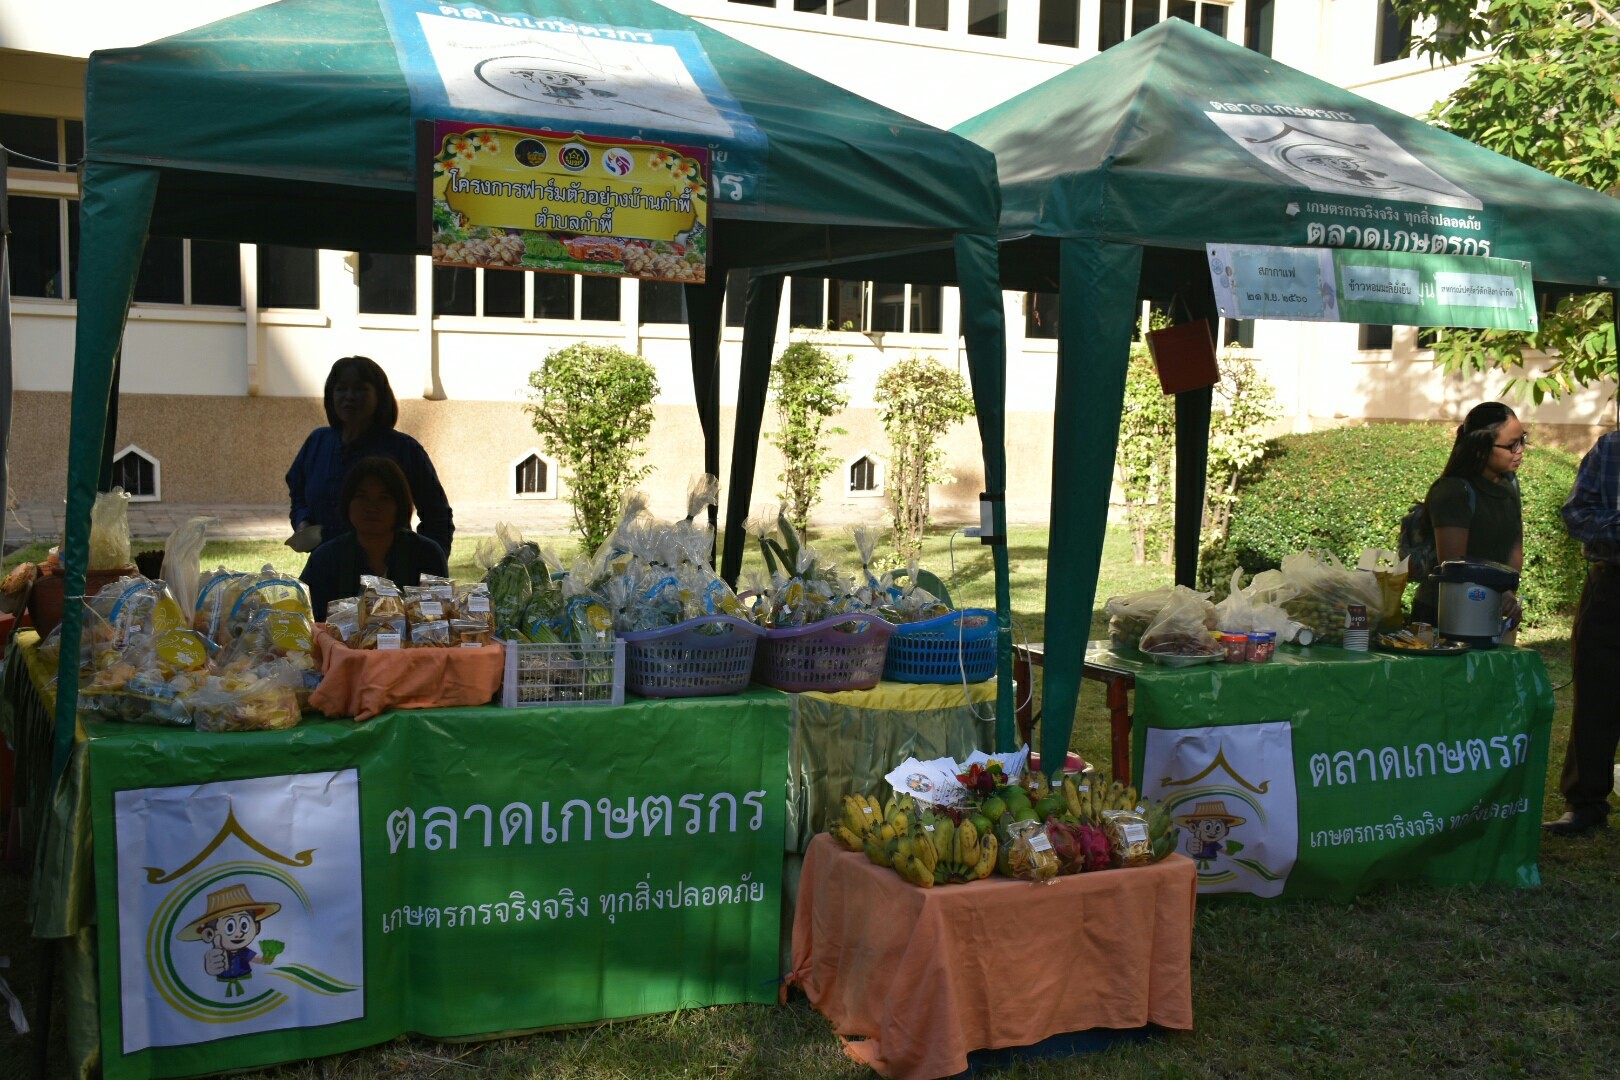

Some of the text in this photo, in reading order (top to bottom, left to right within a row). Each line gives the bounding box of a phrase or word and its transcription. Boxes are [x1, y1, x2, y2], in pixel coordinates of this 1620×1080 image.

[439, 4, 653, 43] ตลาดเกษตรกร
[1209, 100, 1356, 121] ตลาดเกษตรกร
[449, 168, 693, 213] โครงการฟาร์มตัวอย่างบ้านกำพี้
[535, 207, 614, 233] ตำบลกำพี้
[1306, 201, 1481, 231] เกษตรกรจริงจริง ทุกสิ่งปลอดภัย
[1306, 222, 1491, 258] ตลาดเกษตรกร
[1258, 266, 1296, 278] สภากาแฟ
[1309, 733, 1531, 788] ตลาดเกษตรก
[386, 789, 767, 854] ตลาดเกษตรกร
[1310, 811, 1444, 849] เกษตรกรจริงจริง
[382, 872, 765, 934] เกษตรกรจริงจริง ทุกสิ่งปลอดภัย
